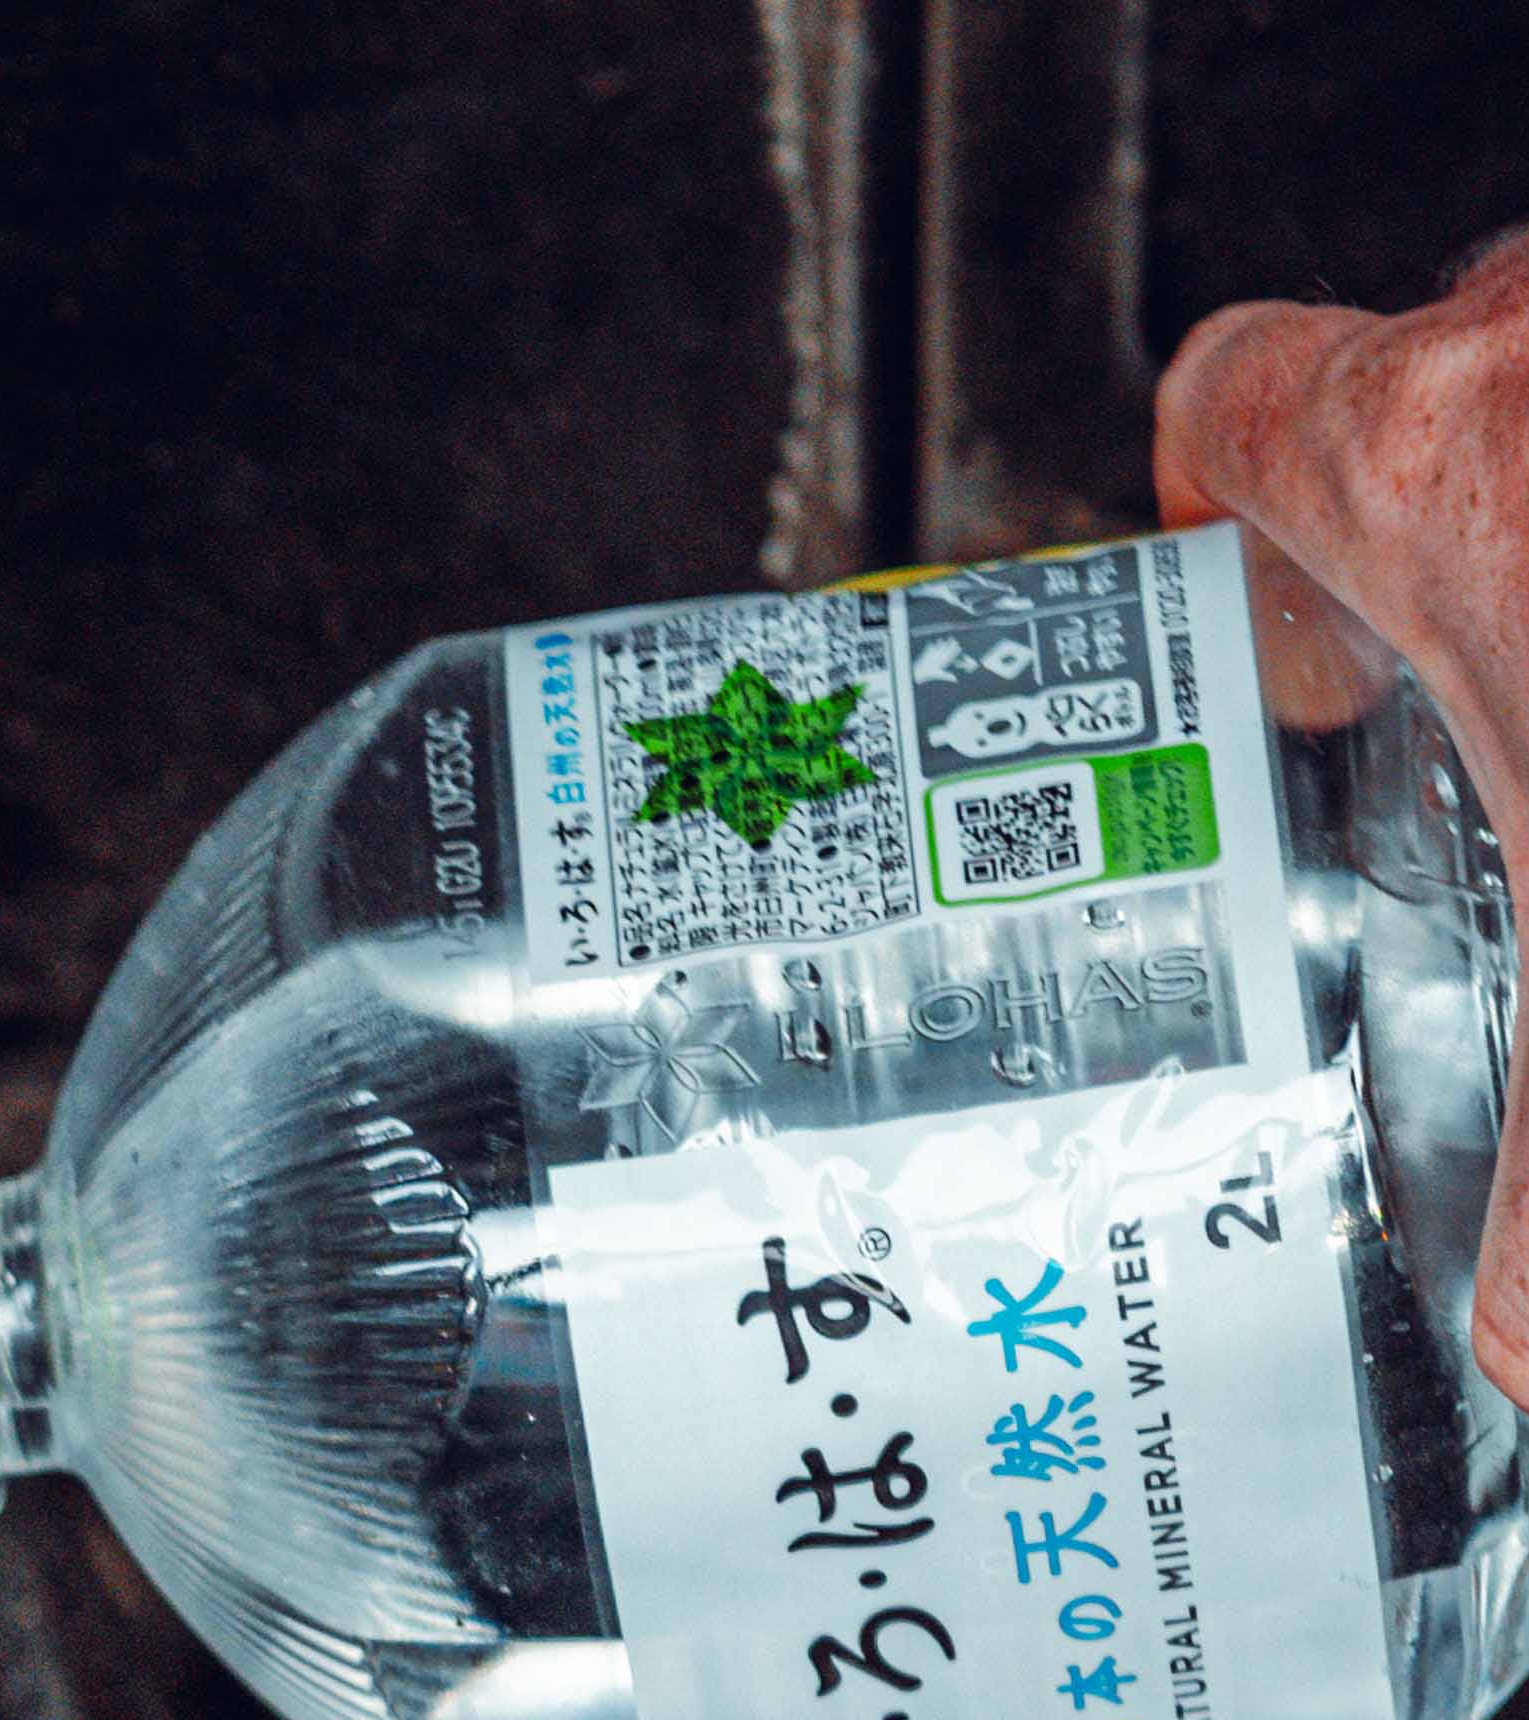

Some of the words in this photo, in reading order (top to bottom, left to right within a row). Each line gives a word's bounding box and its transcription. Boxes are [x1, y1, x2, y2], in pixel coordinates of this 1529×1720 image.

[842, 946, 1209, 1051] LOHAS
[1204, 1151, 1282, 1250] 2L
[1109, 1217, 1165, 1398] WATER
[1137, 1411, 1192, 1592] MINERAL
